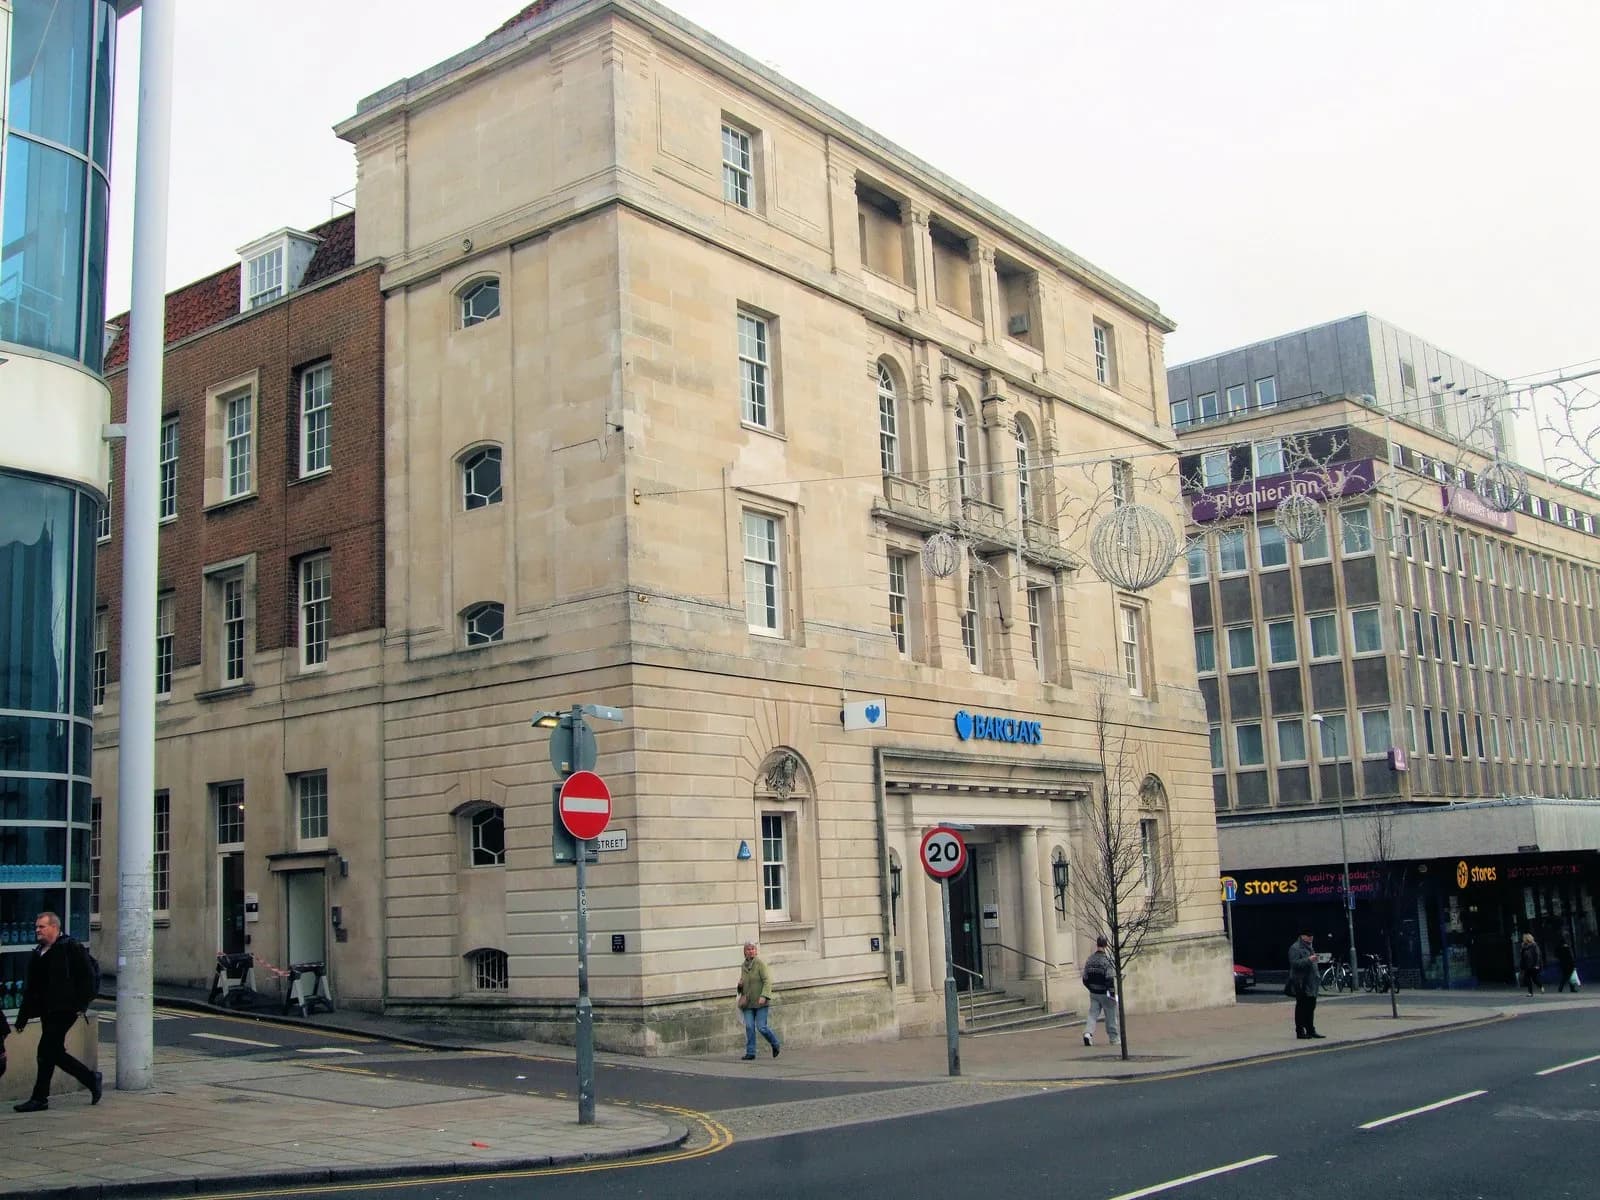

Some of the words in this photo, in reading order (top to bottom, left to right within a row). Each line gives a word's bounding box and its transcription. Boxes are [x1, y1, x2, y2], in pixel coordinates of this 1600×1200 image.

[1215, 485, 1285, 511] Premier
[974, 715, 1042, 745] BARCLAYS
[928, 842, 959, 862] 20
[1304, 870, 1334, 883] quality
[1338, 869, 1380, 882] poducts
[1470, 865, 1497, 882] stores
[1244, 879, 1298, 895] stores
[1308, 883, 1334, 894] under
